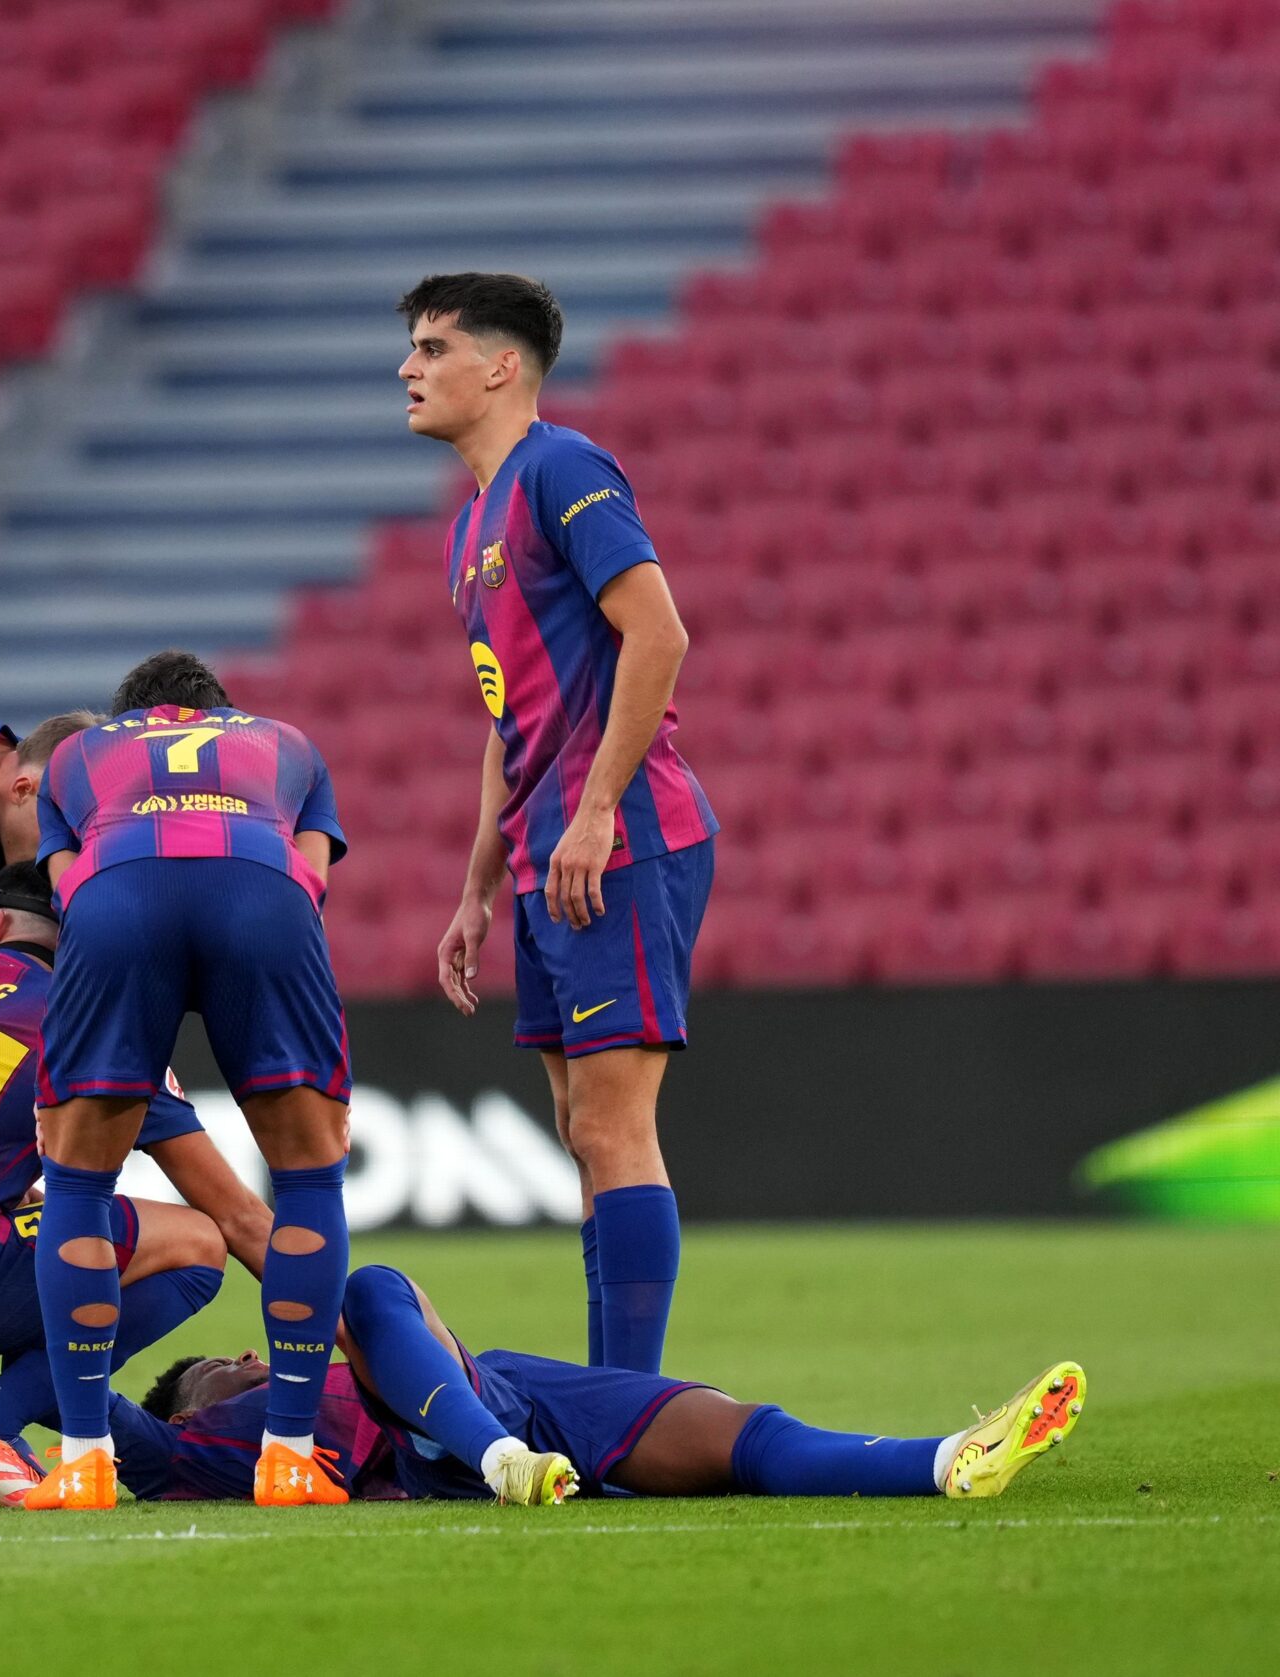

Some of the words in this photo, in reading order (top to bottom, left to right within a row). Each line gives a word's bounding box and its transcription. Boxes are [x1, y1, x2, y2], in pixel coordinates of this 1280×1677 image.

[560, 488, 610, 526] AMBILIGHT
[134, 727, 225, 773] 7
[180, 794, 248, 809] UNHCR
[68, 1340, 115, 1352] BARÇA
[274, 1340, 325, 1353] BARÇA
